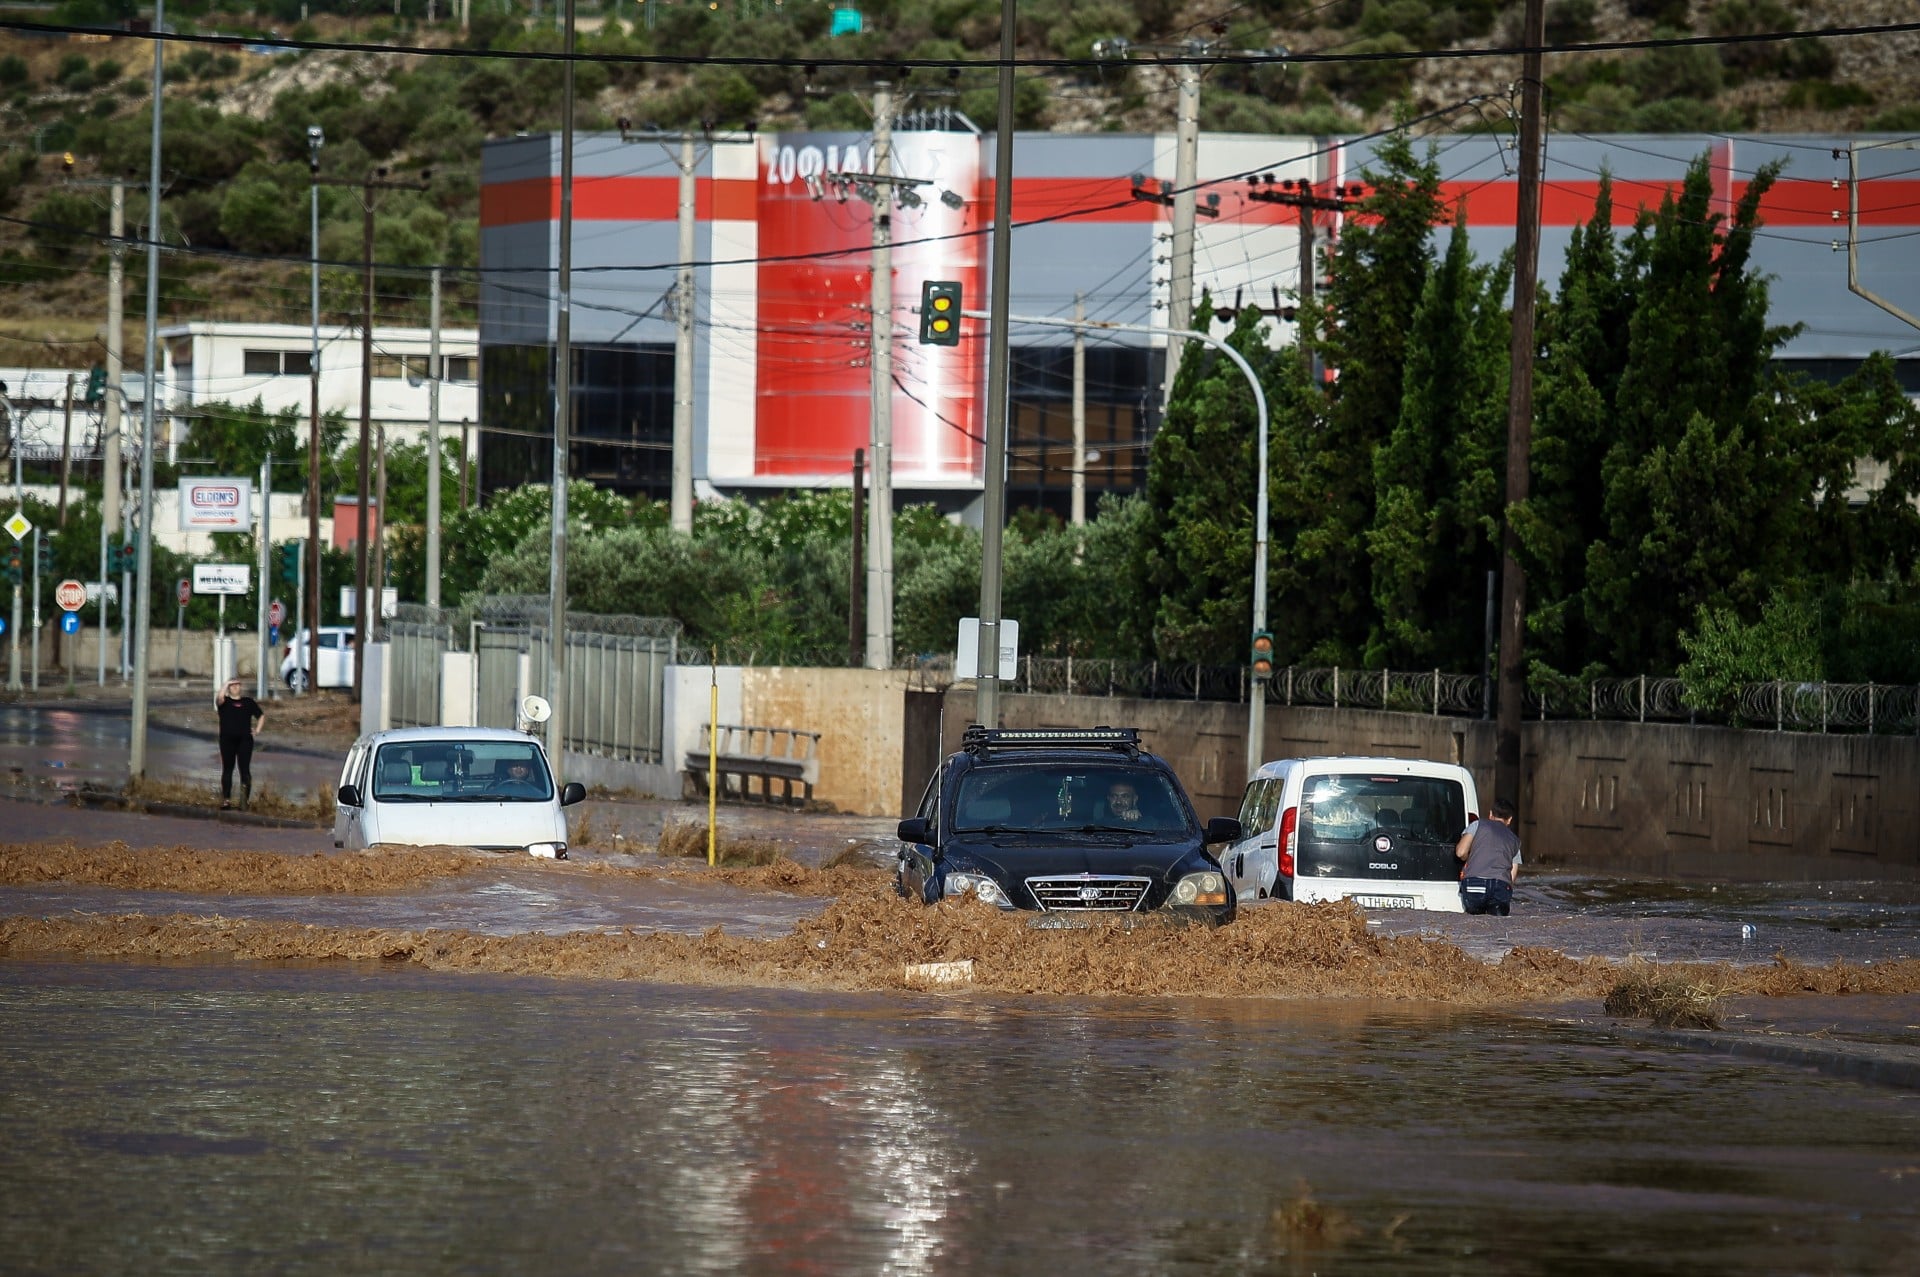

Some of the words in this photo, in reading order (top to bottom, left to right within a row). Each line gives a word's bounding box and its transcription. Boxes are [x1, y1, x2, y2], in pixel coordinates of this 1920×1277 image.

[196, 492, 234, 503] ELDON'S
[58, 589, 82, 604] STOP
[1368, 862, 1398, 870] DOBLO
